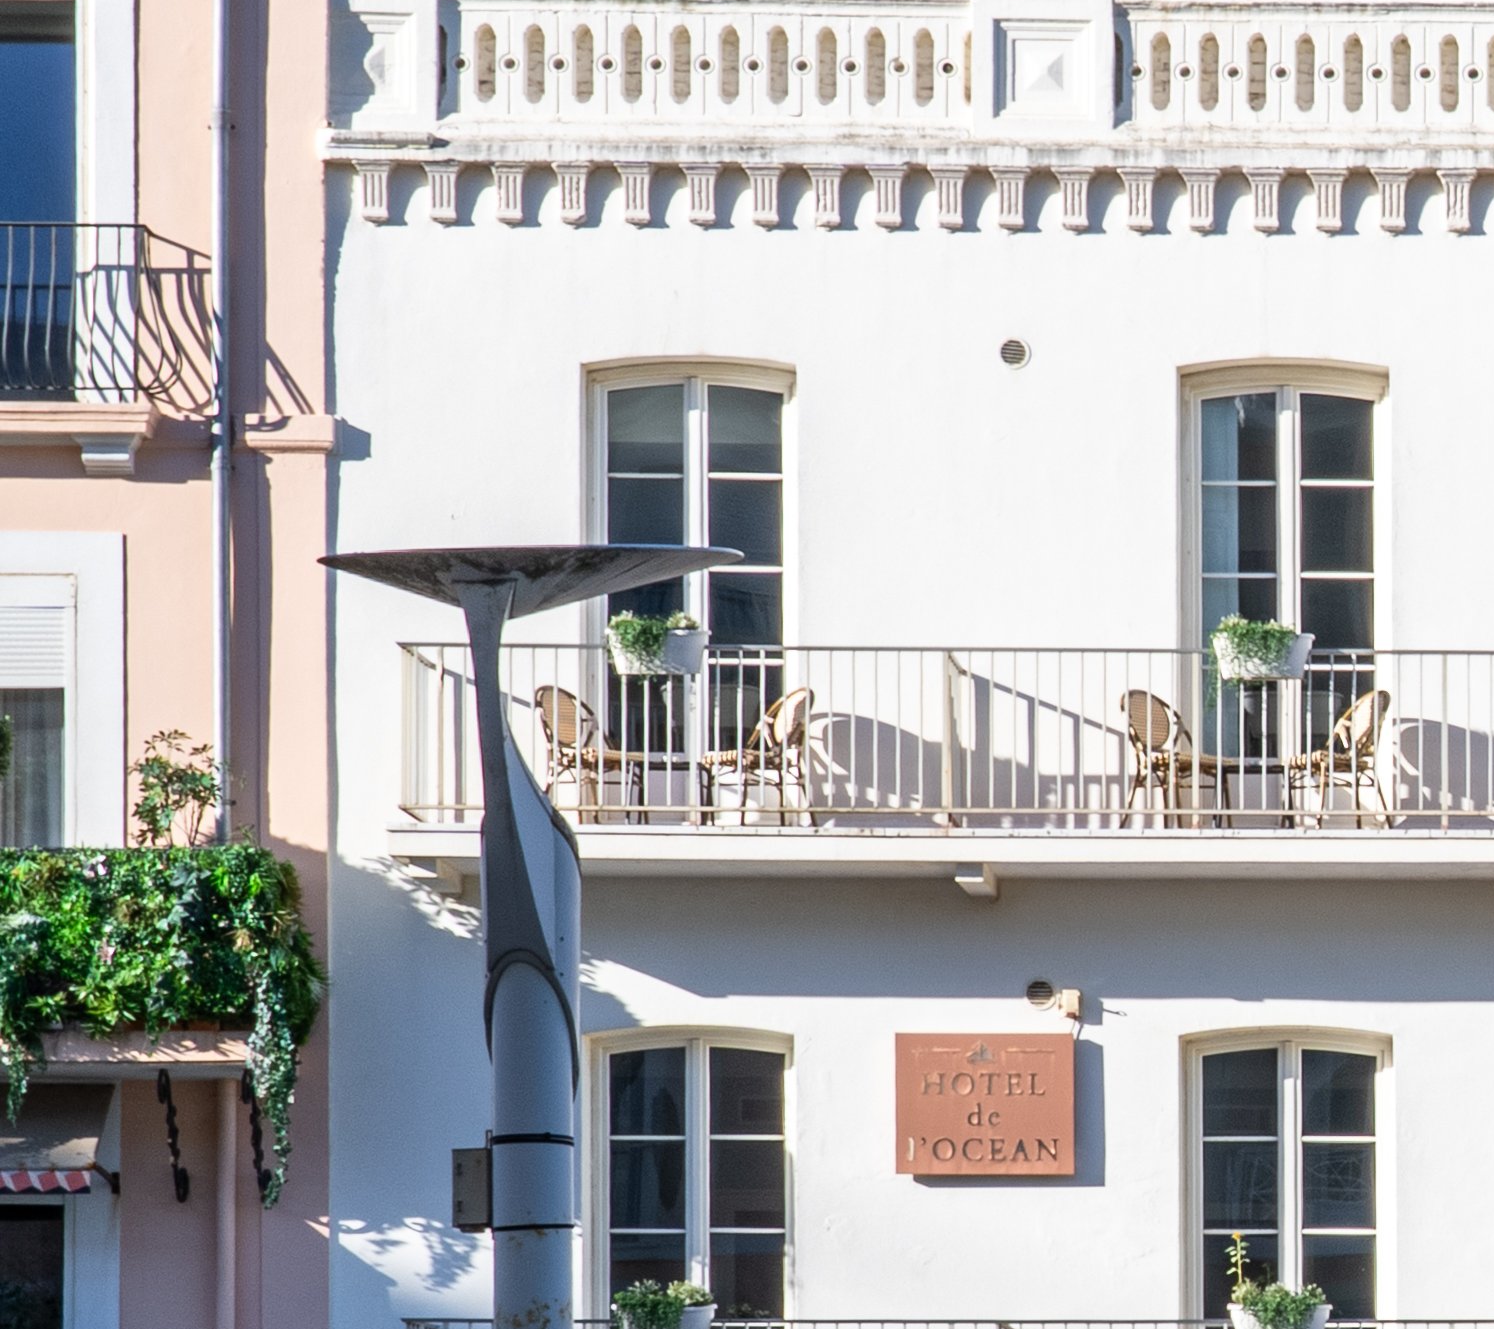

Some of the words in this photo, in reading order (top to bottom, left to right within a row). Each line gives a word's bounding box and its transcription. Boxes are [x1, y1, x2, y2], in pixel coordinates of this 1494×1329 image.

[921, 1072, 1046, 1096] HOTEL
[967, 1103, 1001, 1126] de
[907, 1137, 1060, 1162] l'OCEAN
